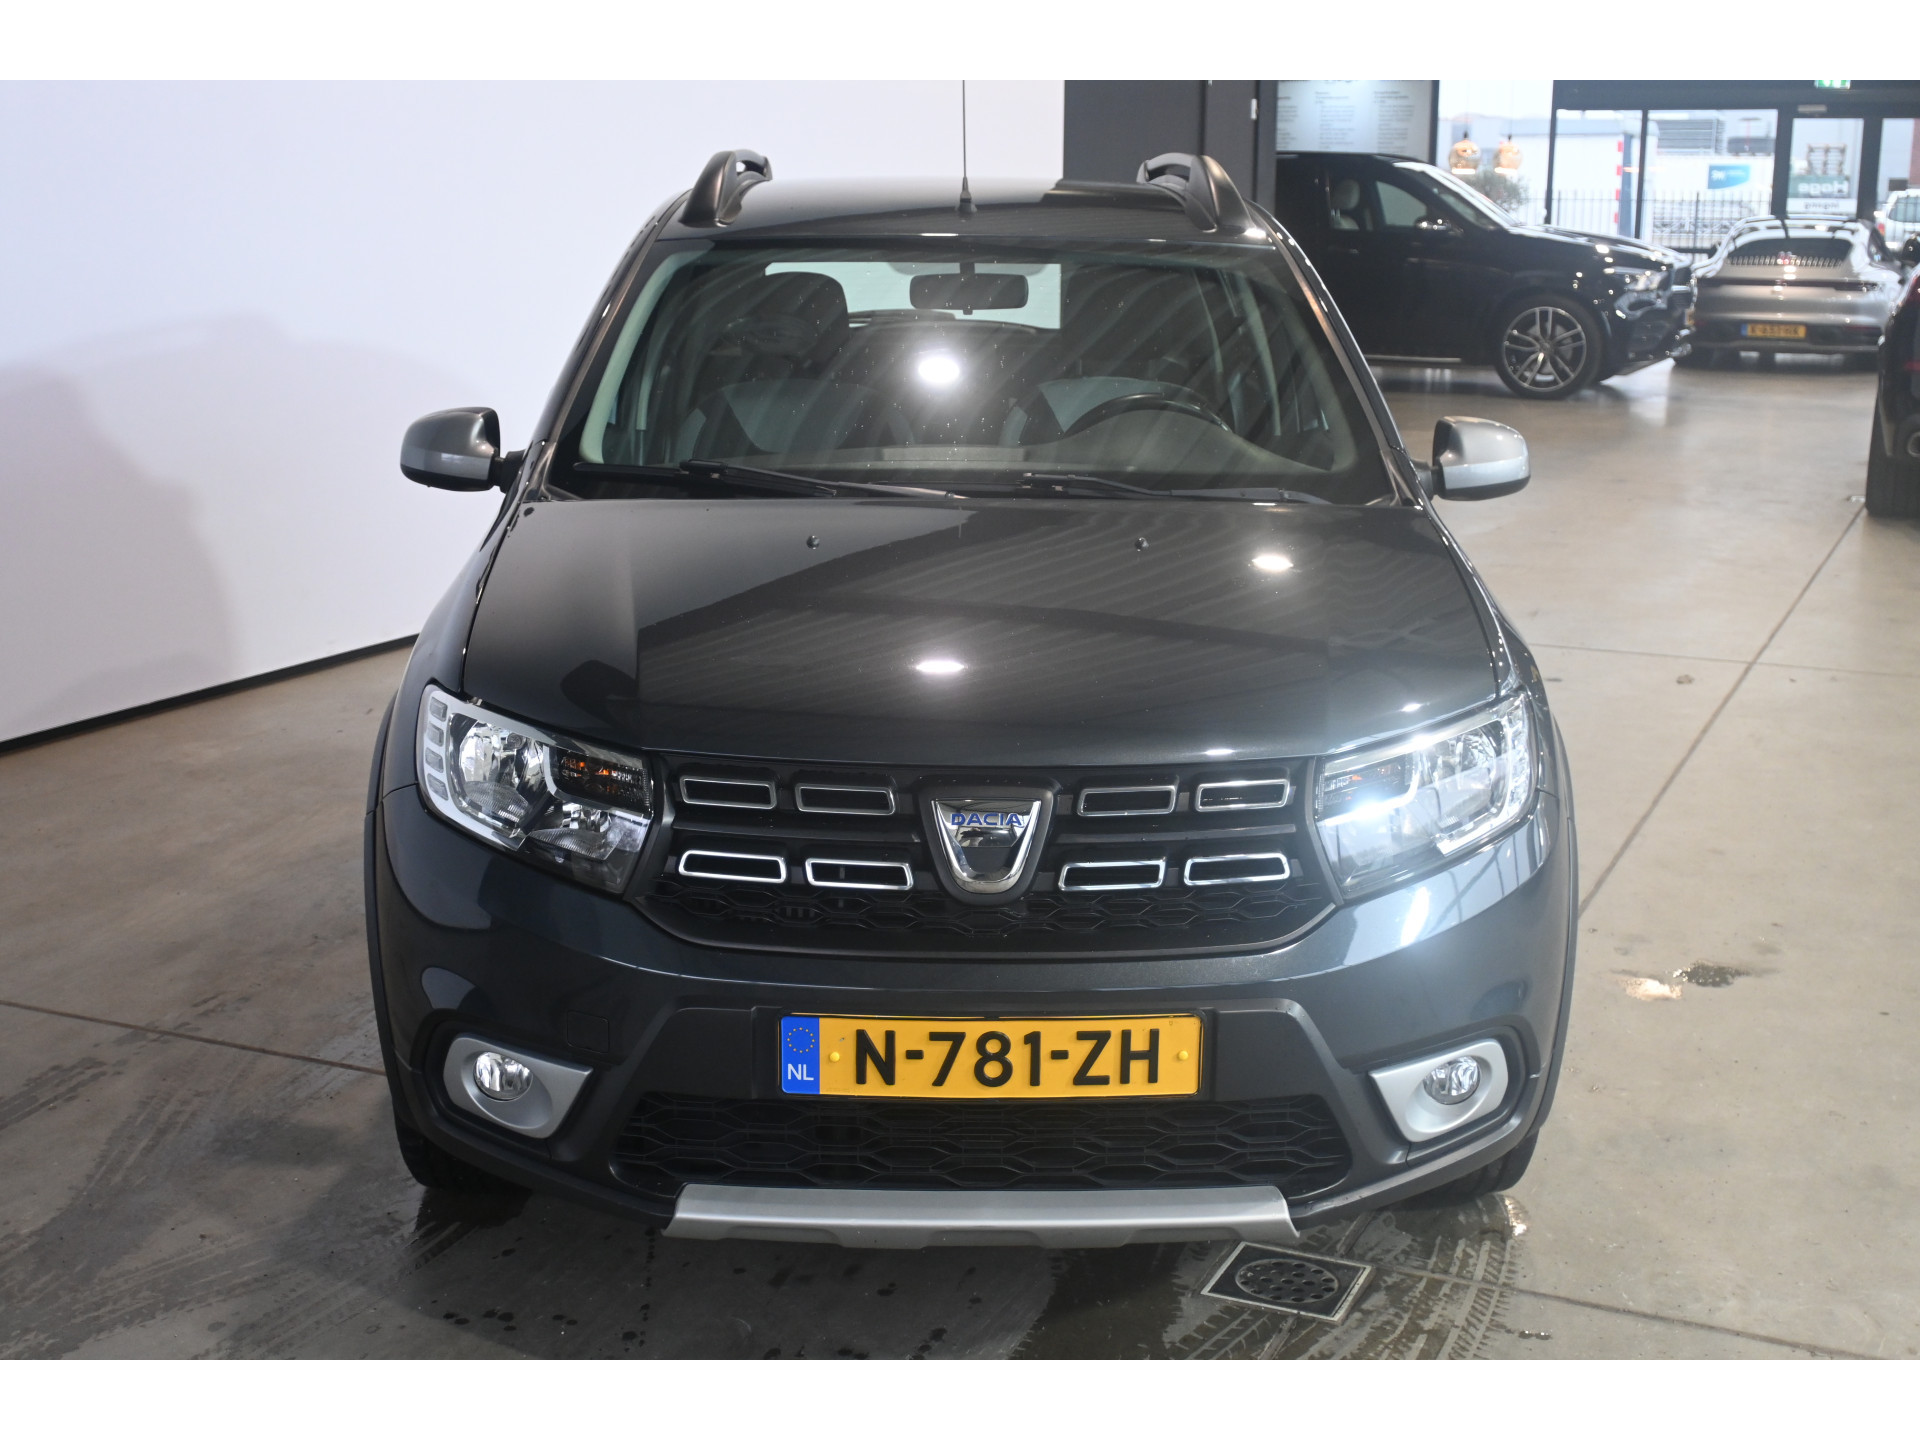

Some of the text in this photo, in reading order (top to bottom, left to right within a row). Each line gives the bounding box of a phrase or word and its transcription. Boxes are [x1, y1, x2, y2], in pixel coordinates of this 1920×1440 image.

[951, 812, 1023, 826] DACIA
[787, 1028, 1160, 1087] NL N-781-ZH
